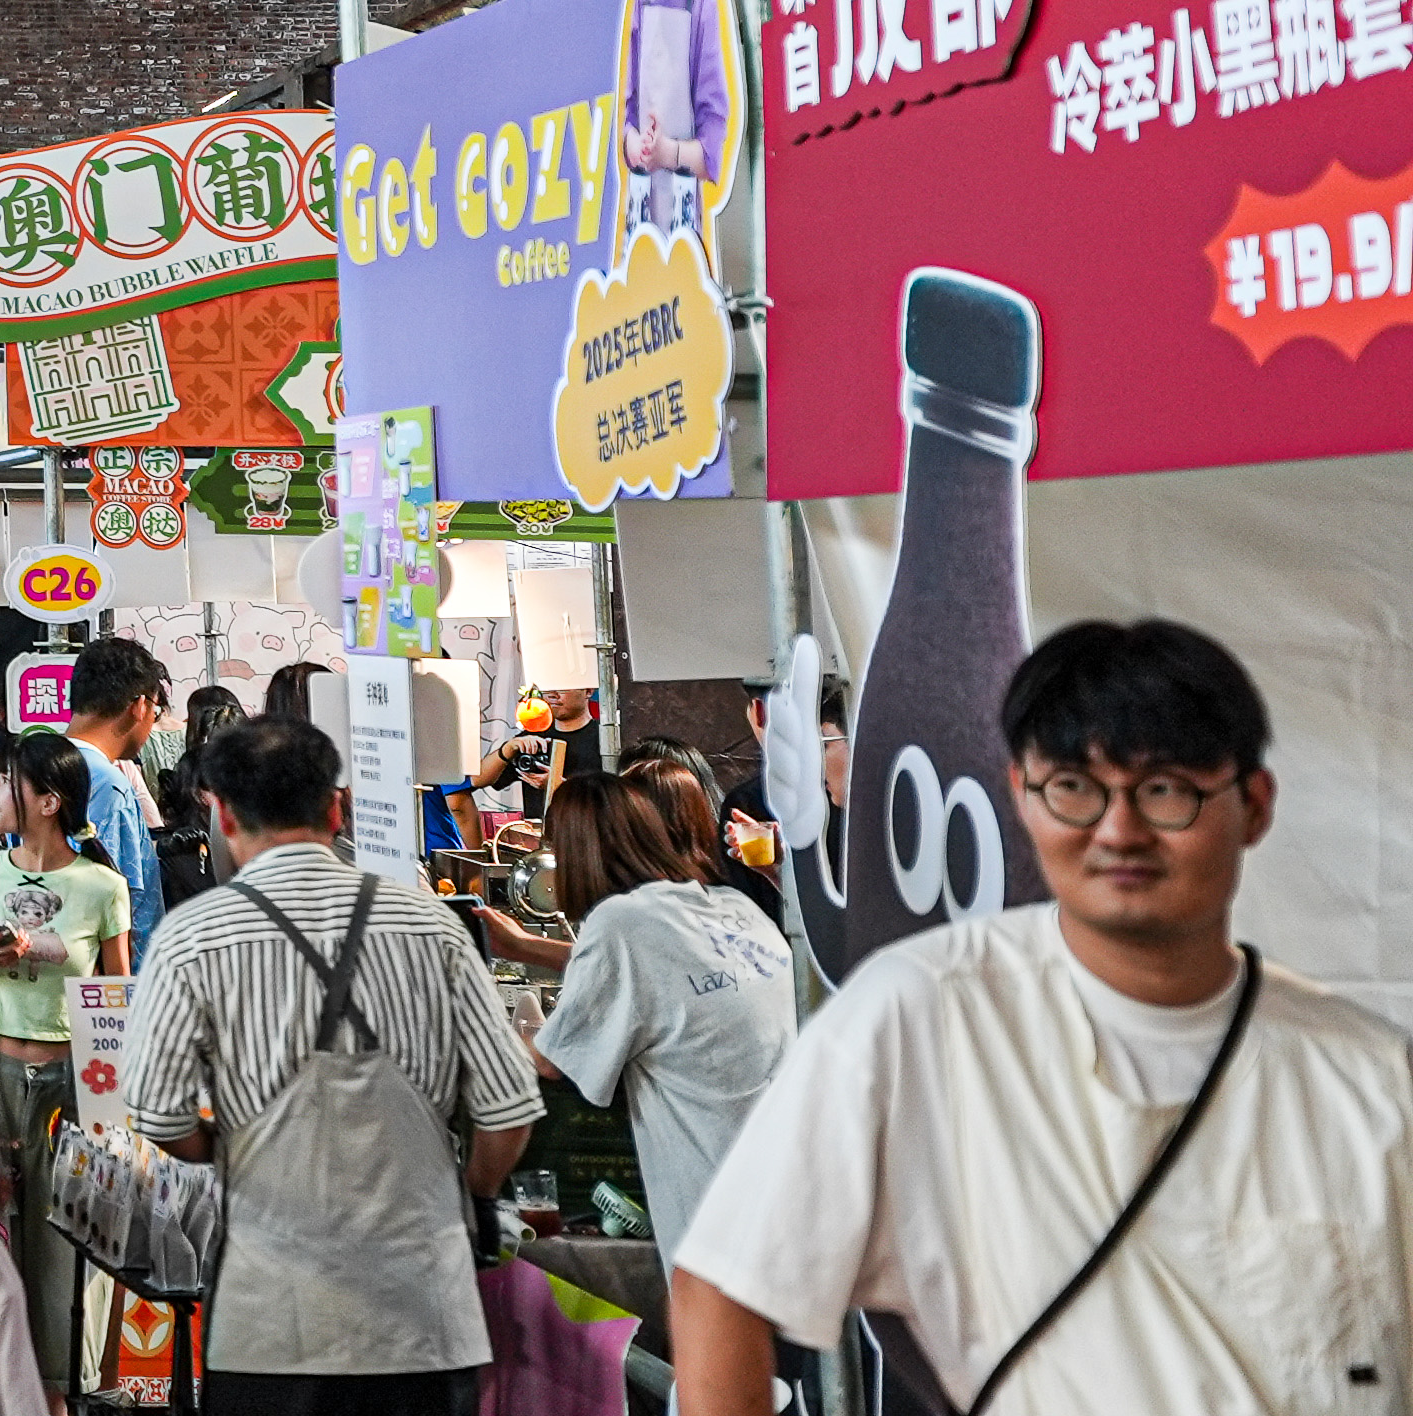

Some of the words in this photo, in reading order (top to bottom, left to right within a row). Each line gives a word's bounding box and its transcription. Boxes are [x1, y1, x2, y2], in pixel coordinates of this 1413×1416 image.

[1, 289, 84, 316] MACAO
[89, 262, 183, 303] BUBBLE
[185, 242, 279, 280] WAFFLE
[582, 297, 685, 383] 2025年CBRC
[597, 381, 688, 463] 总决赛亚军
[103, 446, 174, 473] 正宗
[238, 452, 297, 467] 开心拿铁
[102, 478, 175, 494] MACAO
[103, 495, 140, 503] COFFEE
[141, 495, 173, 504] STORE
[101, 507, 176, 538] 澳挞
[23, 567, 97, 602] C26
[93, 1038, 123, 1051] 200
